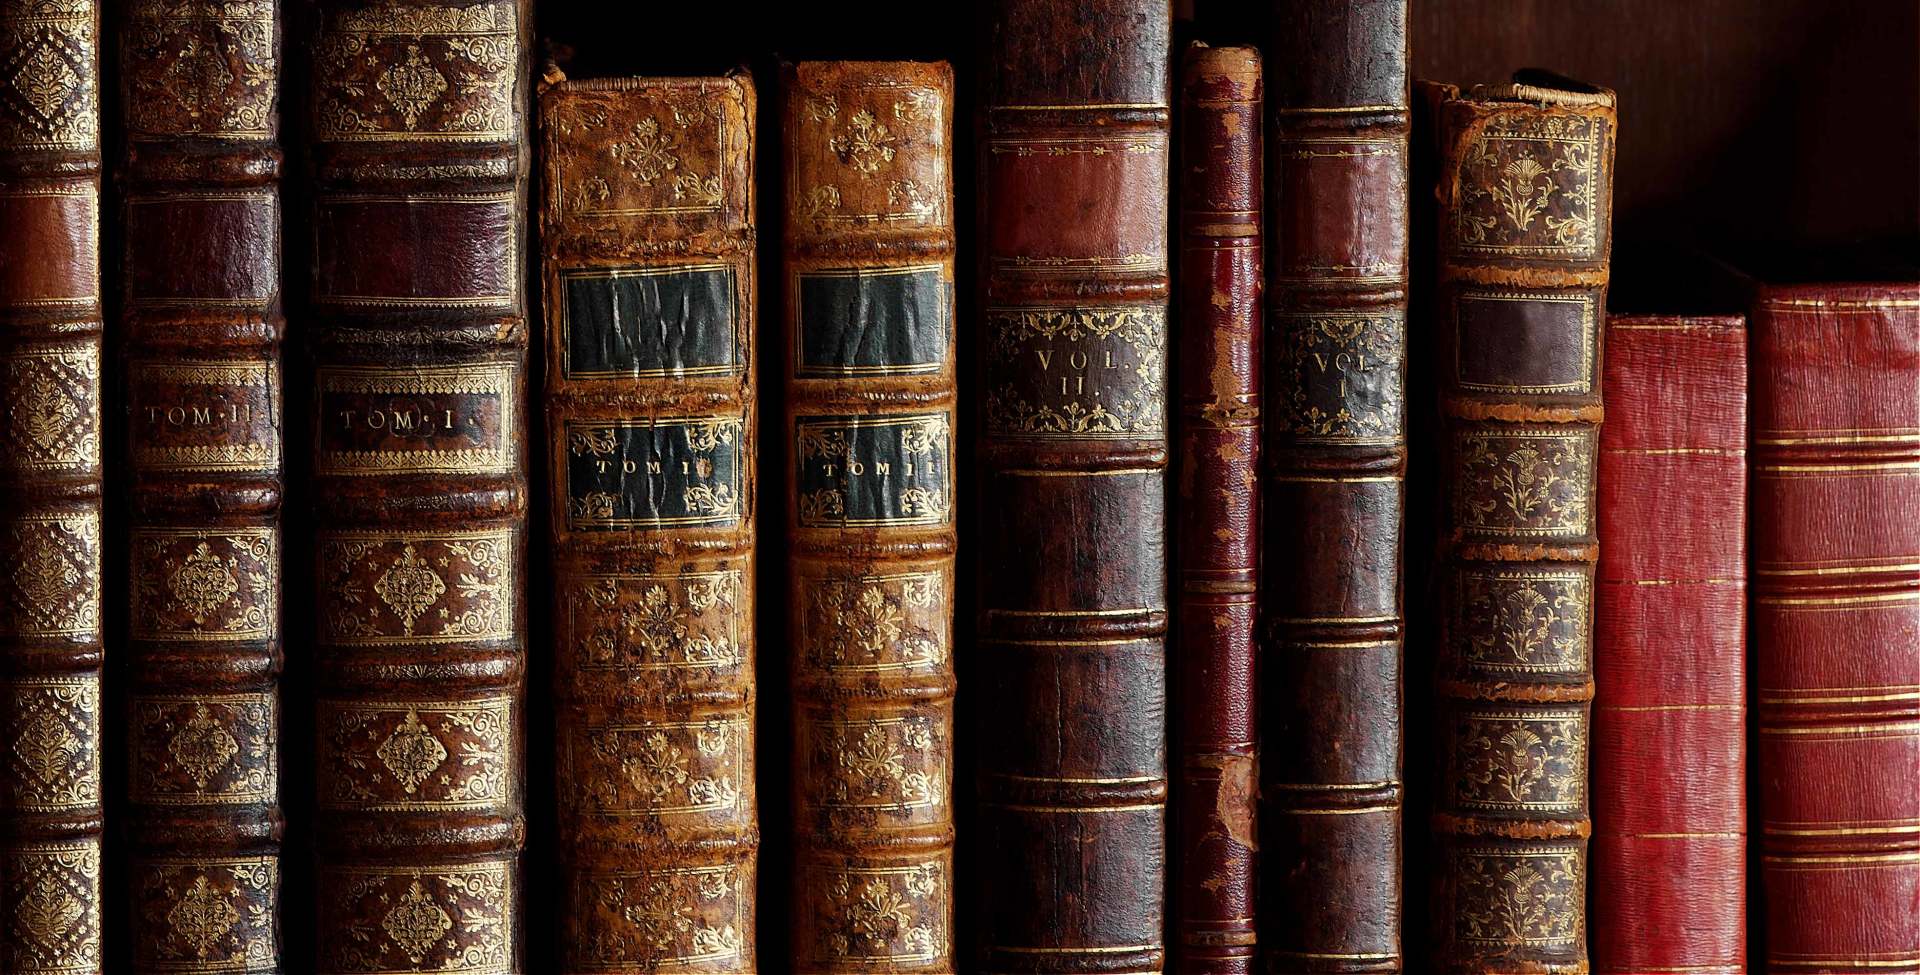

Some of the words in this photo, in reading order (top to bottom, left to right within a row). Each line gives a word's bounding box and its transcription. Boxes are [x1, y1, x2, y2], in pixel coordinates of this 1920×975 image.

[1034, 350, 1130, 371] VOL.
[596, 460, 661, 475] TOM
[822, 462, 891, 477] TOM
